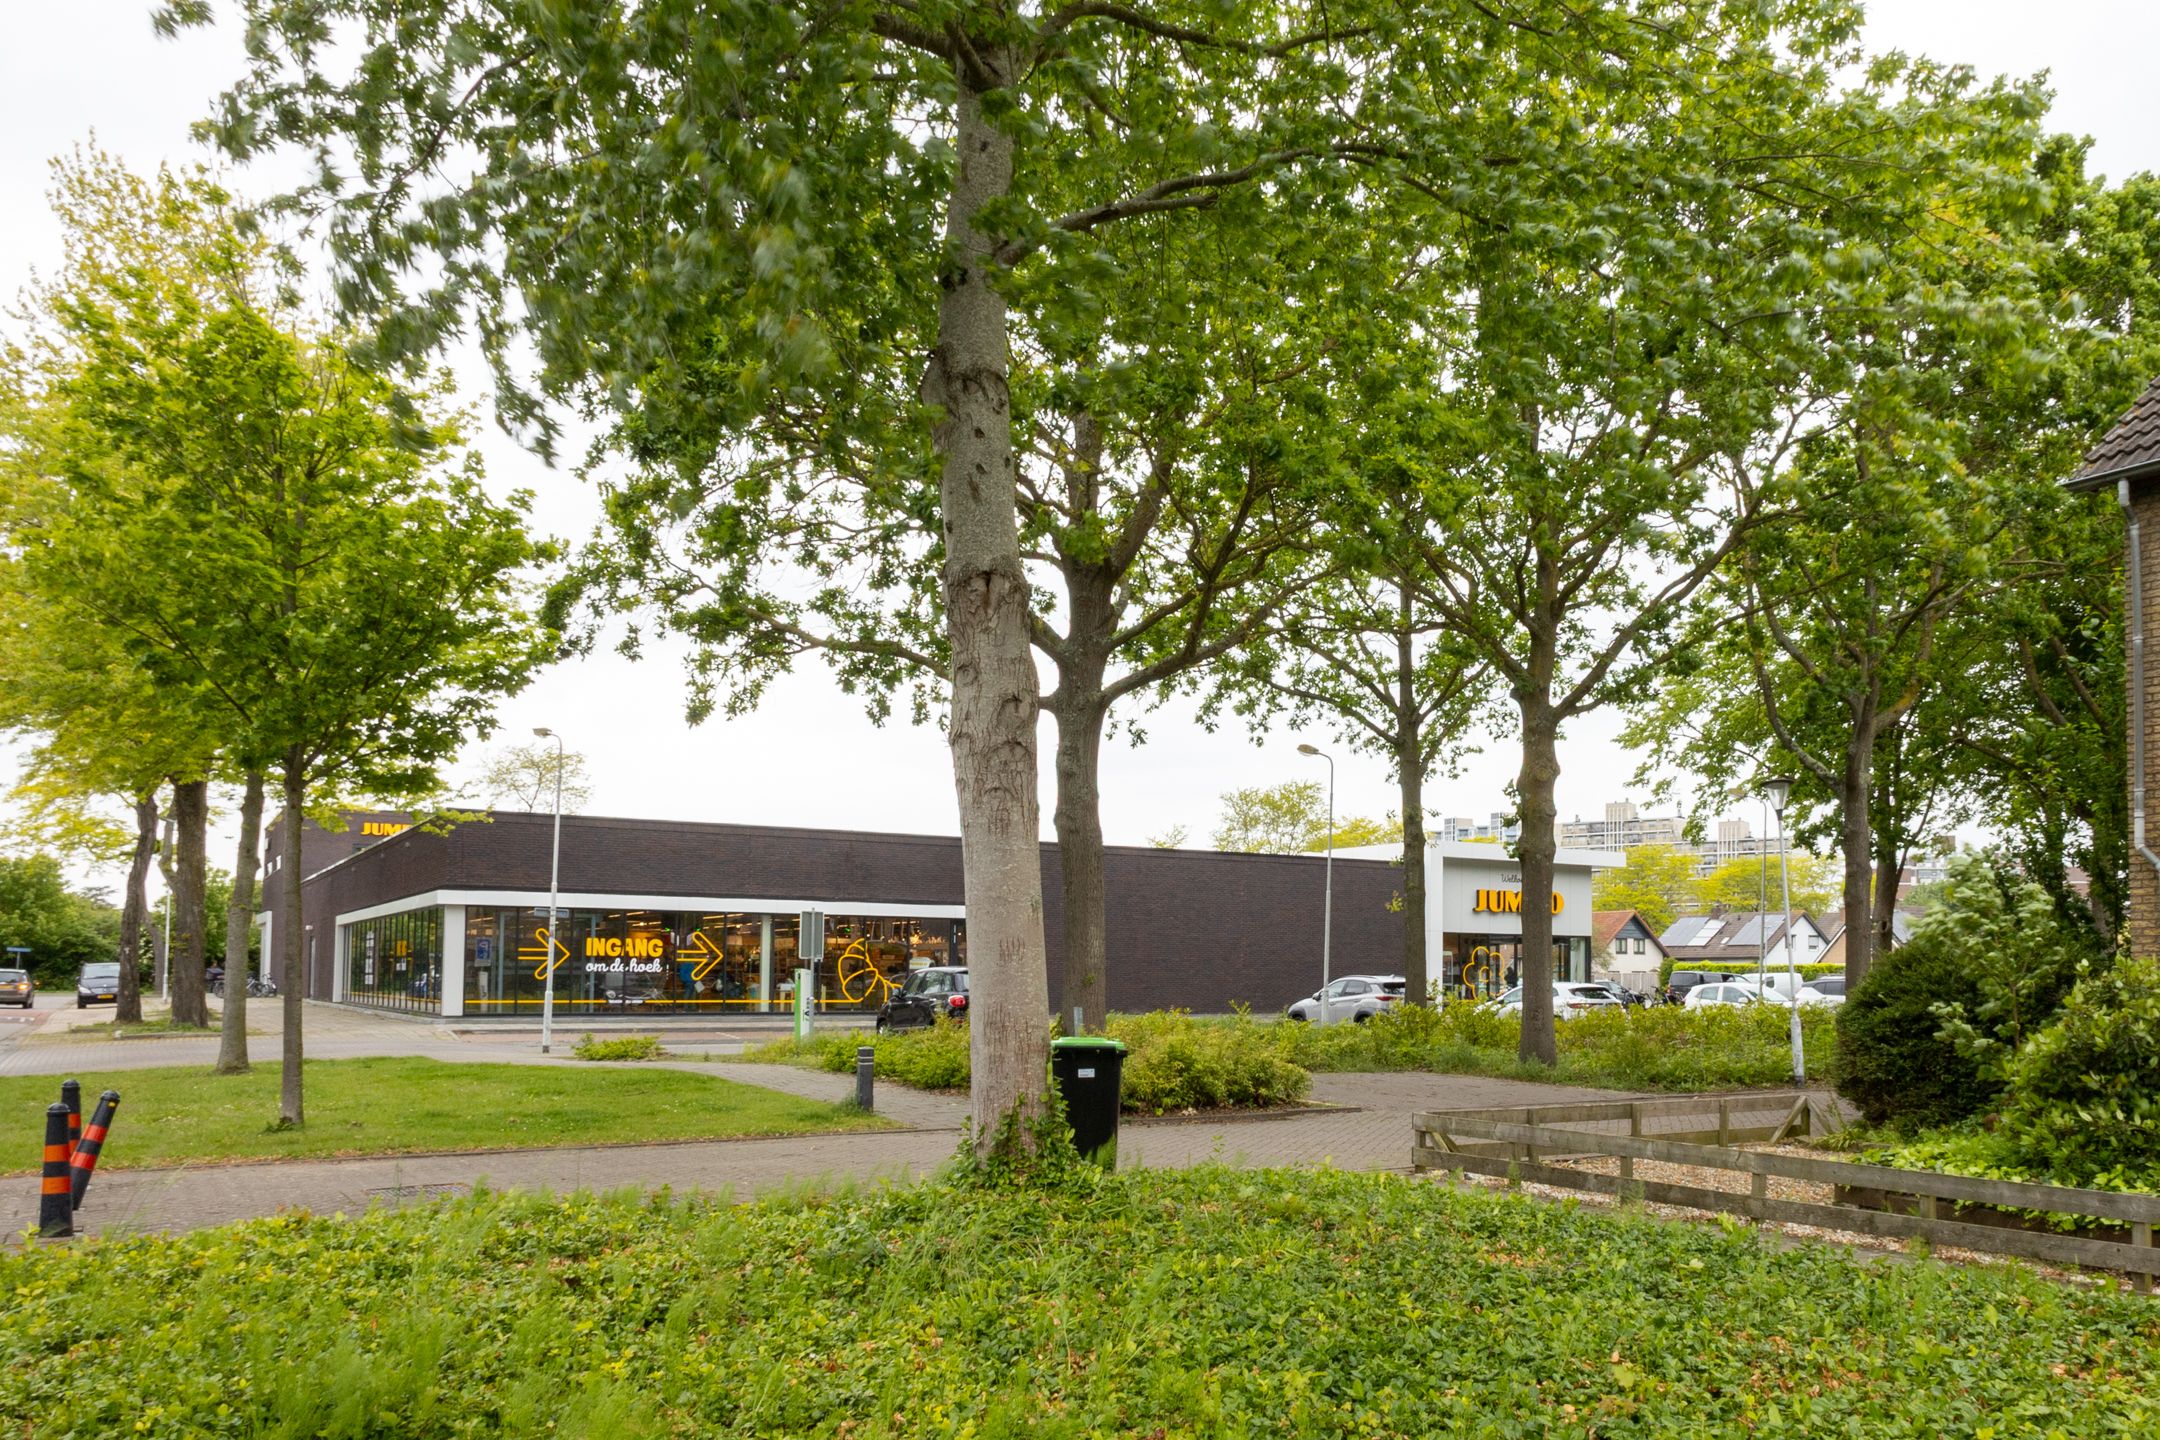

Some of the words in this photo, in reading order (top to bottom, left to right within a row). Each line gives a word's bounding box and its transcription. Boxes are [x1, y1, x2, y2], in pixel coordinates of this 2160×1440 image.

[360, 822, 413, 836] JUM
[1501, 873, 1522, 883] Welko
[1474, 888, 1565, 915] JUMO
[586, 937, 664, 958] INGANG
[585, 962, 609, 972] om
[629, 958, 663, 973] hoek
